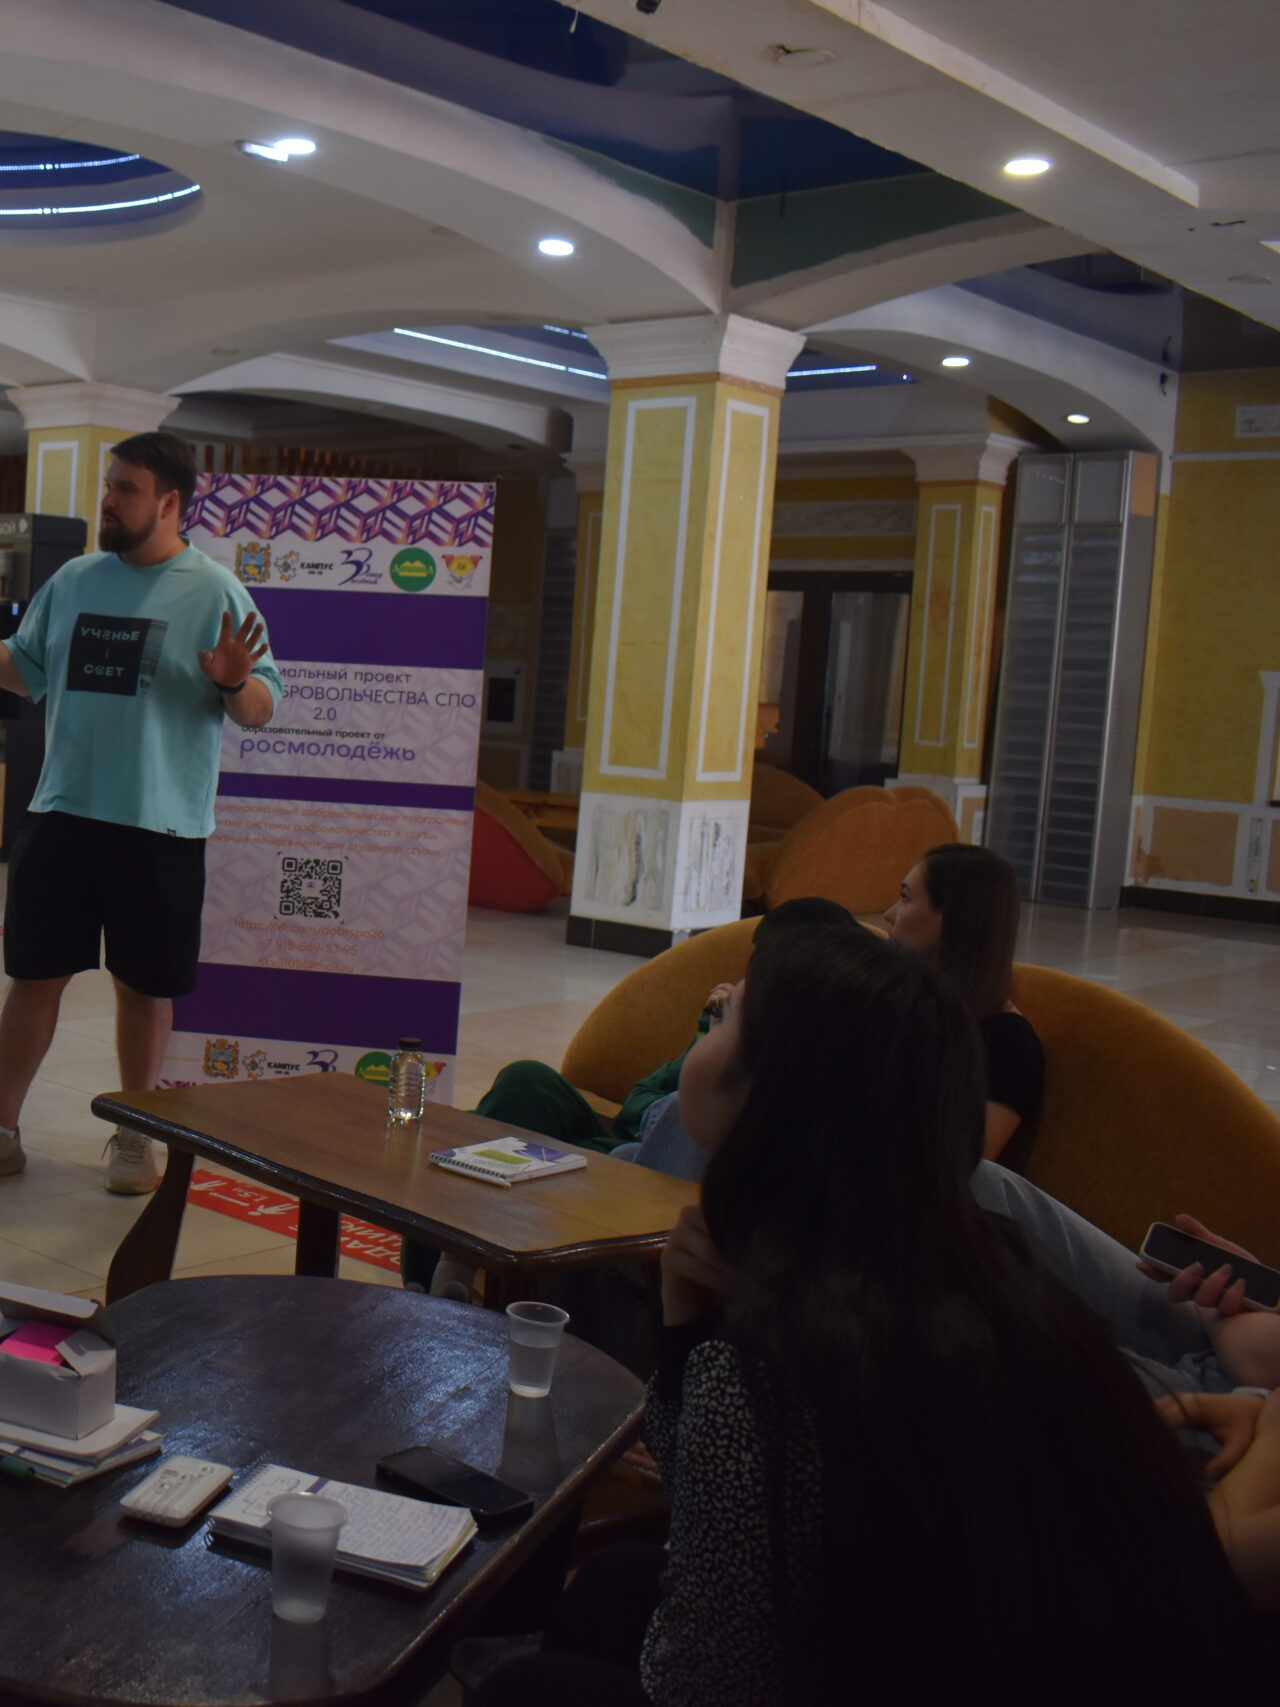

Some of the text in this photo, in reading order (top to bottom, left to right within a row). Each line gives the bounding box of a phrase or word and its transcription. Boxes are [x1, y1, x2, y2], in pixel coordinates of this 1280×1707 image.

[278, 667, 412, 684] иальный проект
[282, 685, 476, 708] БРОВОЛЬЧЕСТВА СПО
[313, 707, 337, 721] 2.0
[335, 730, 372, 740] проект
[239, 738, 415, 761] росмолодёжь
